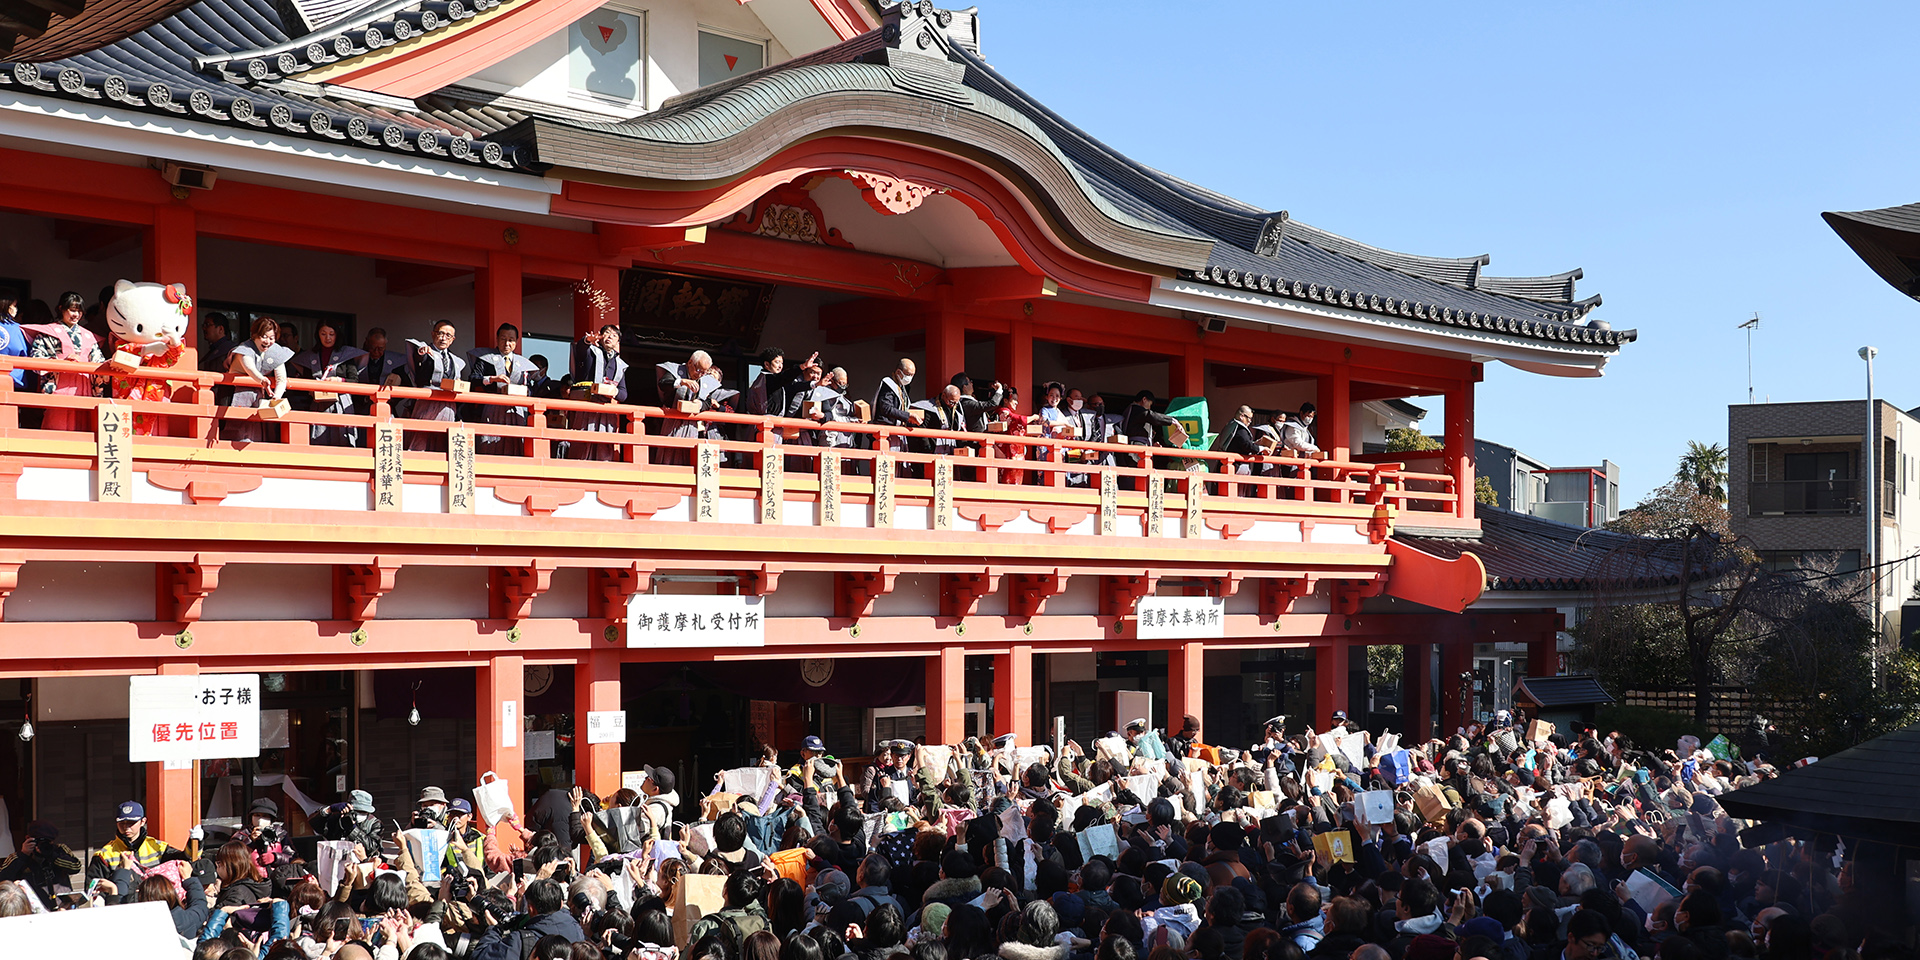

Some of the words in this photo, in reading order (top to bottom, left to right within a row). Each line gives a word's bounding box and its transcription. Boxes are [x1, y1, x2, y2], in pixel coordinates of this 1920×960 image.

[122, 411, 130, 438] 年男
[102, 411, 121, 497] ハローキティ殿
[637, 612, 759, 632] 御護摩札受付所
[1142, 608, 1219, 627] 護摩木奉納所
[152, 721, 238, 743] 優先位置
